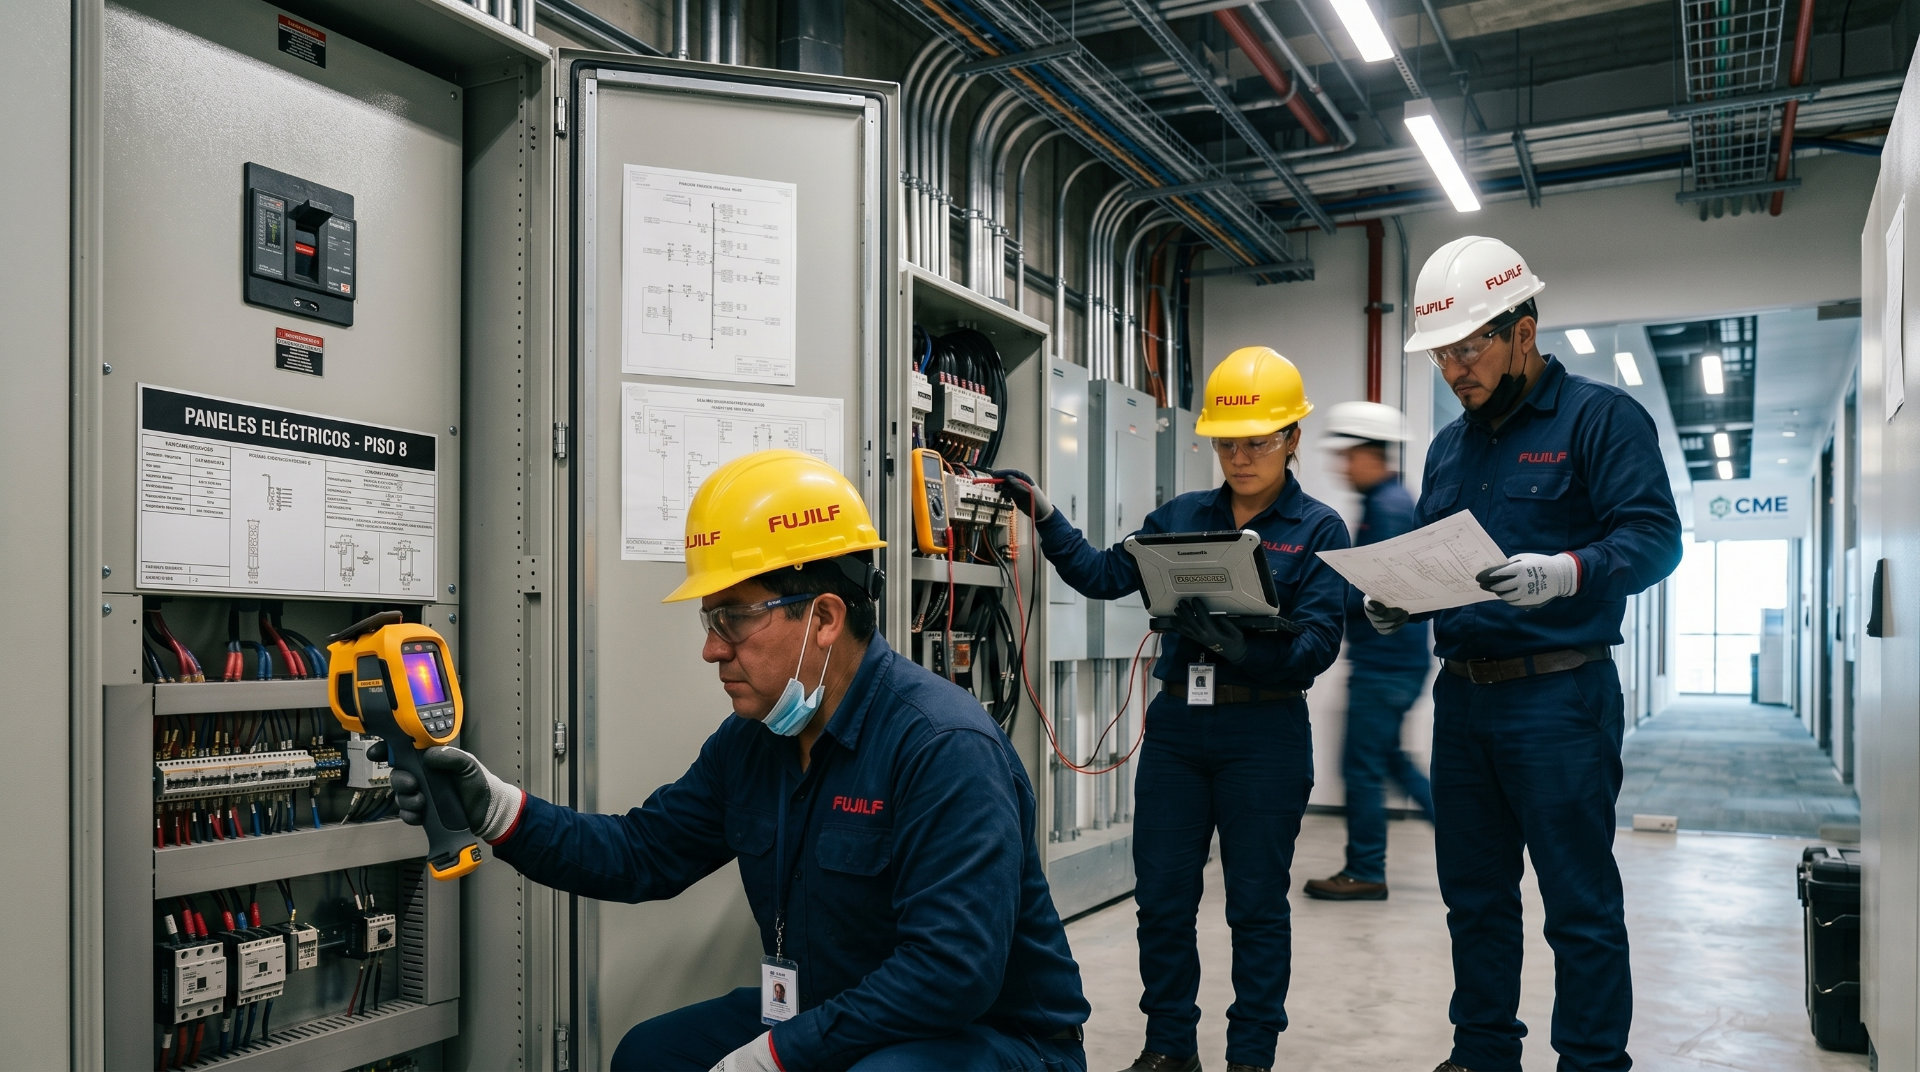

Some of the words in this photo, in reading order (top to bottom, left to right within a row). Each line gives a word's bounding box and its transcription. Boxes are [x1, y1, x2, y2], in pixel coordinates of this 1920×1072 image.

[1216, 394, 1260, 406] FUJILF
[185, 406, 257, 435] PANELES
[261, 418, 350, 449] ELÉCTRICOS
[364, 435, 394, 456] PISO
[398, 441, 408, 457] 8
[1735, 496, 1788, 513] CME
[768, 504, 841, 533] FUJILF
[832, 795, 884, 815] FUJILF
